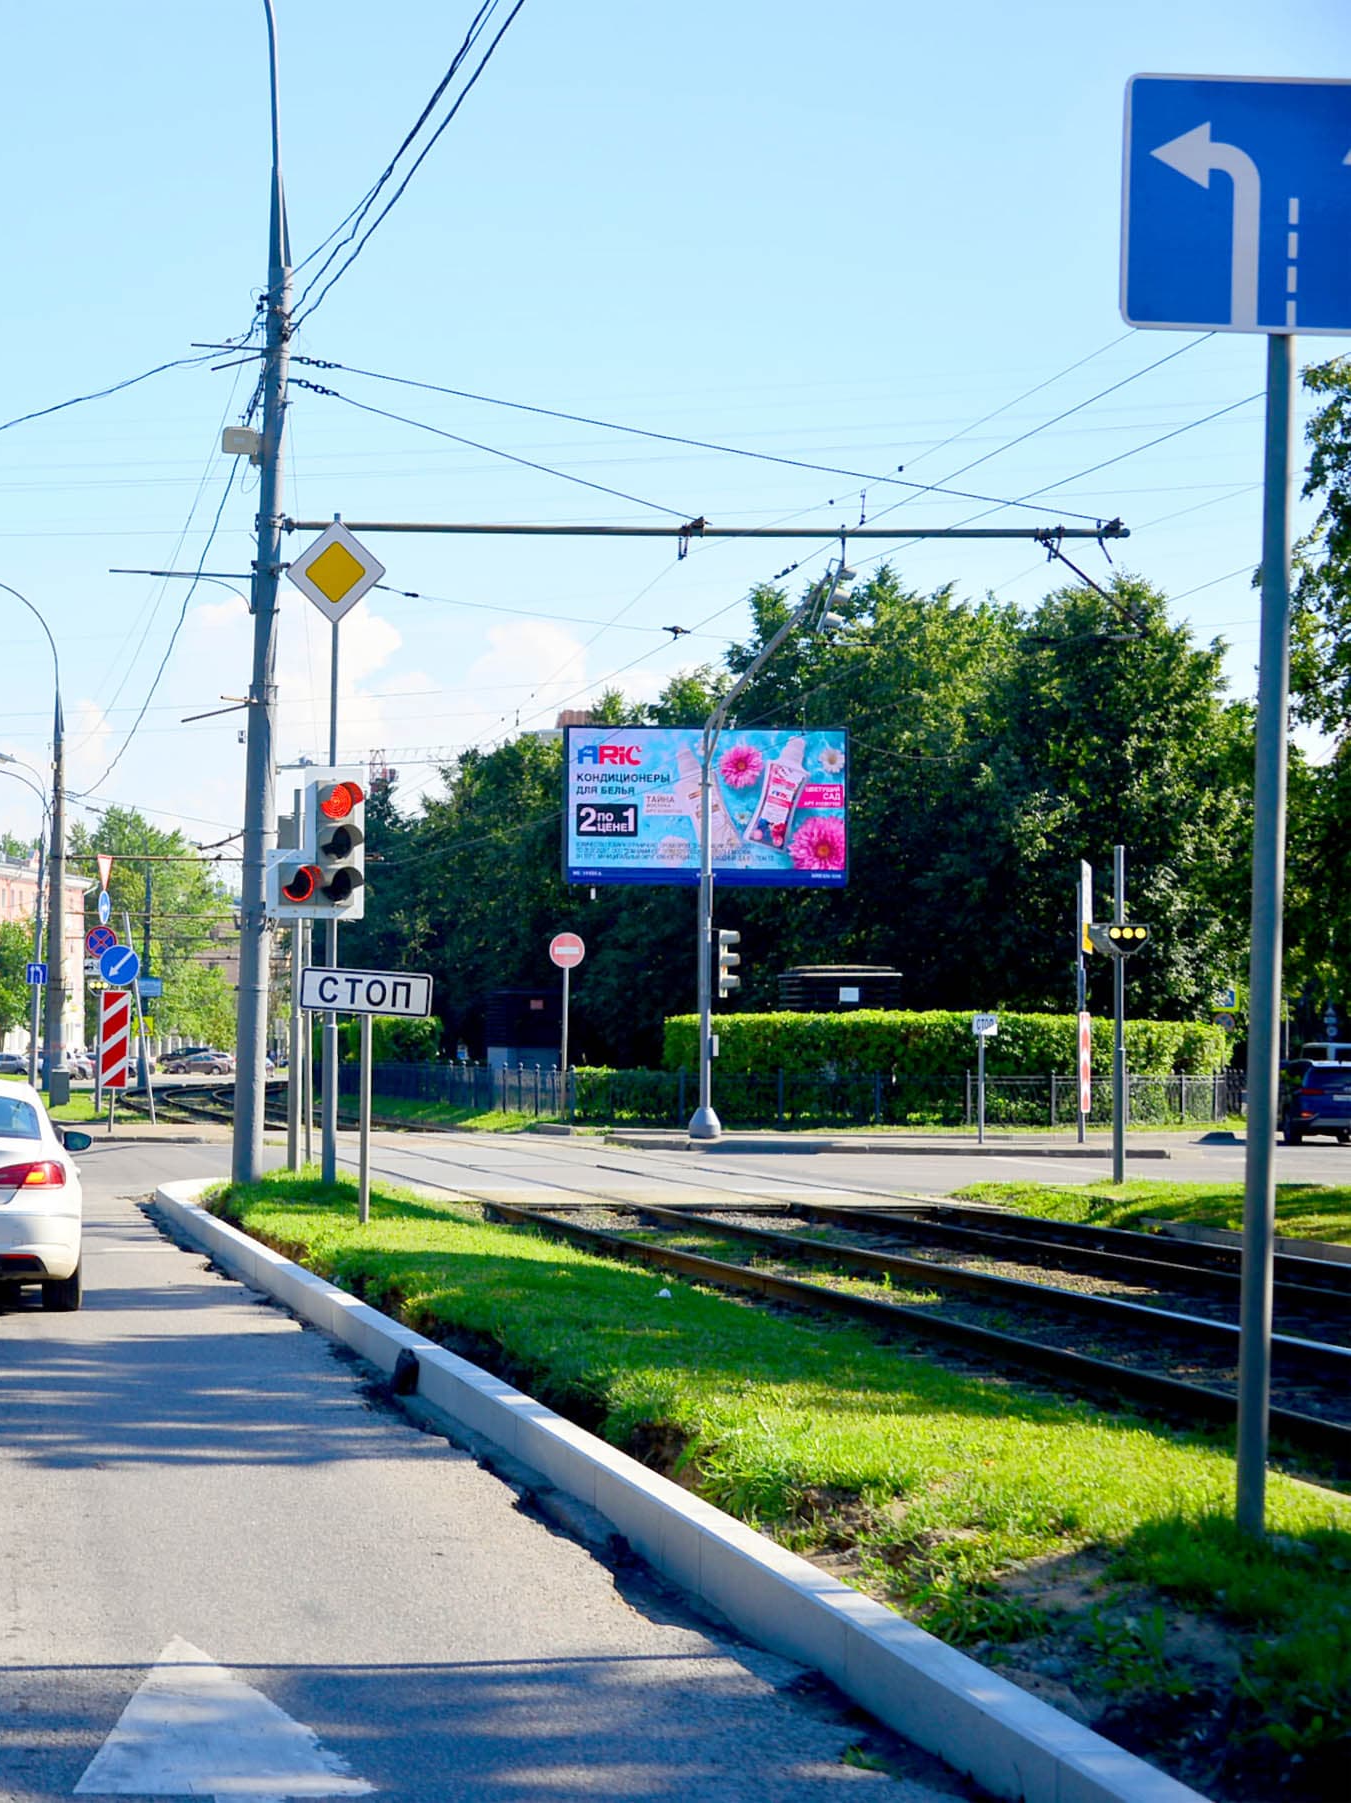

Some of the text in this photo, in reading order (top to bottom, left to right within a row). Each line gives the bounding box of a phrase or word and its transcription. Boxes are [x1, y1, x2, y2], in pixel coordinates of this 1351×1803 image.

[576, 773, 670, 784] КОНДИЦИОНЕРЫ
[576, 786, 635, 795] ДЛЯ БЕЛЬЯ
[822, 793, 841, 801] САД
[579, 807, 596, 832] 2
[597, 823, 628, 833] ЦЕНЕ
[622, 807, 635, 832] 1
[318, 976, 411, 1009] СТОП
